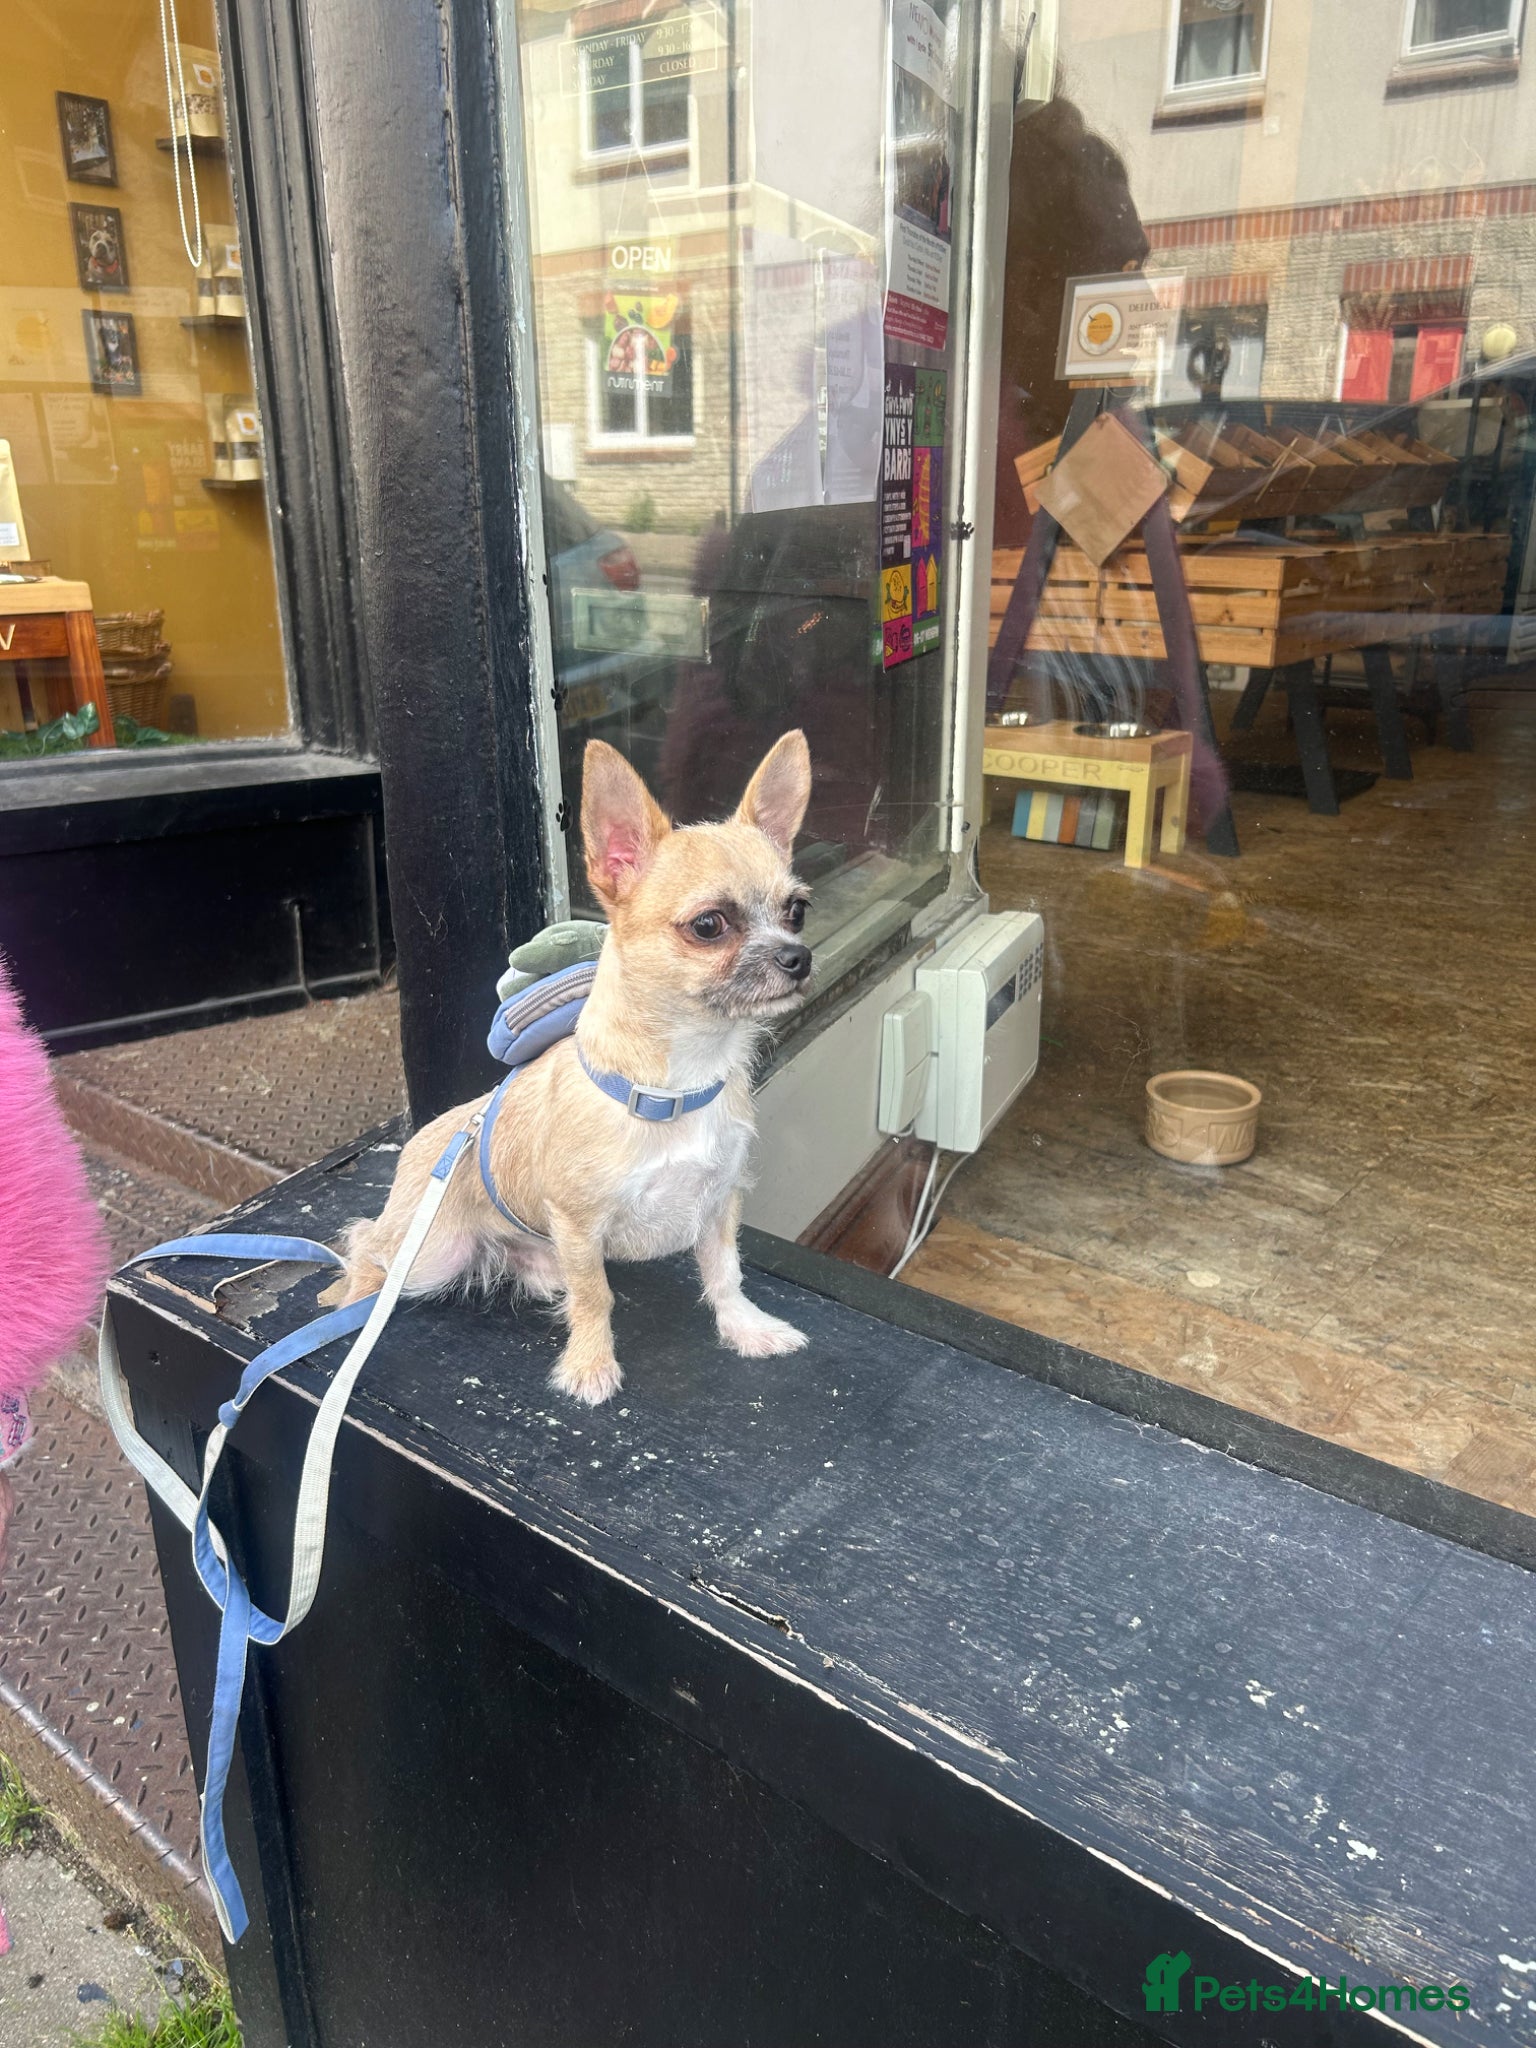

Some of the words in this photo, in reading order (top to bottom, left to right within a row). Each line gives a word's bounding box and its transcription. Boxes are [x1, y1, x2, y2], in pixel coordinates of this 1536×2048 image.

[572, 40, 608, 57] MONDAY
[615, 32, 646, 48] FRIDAY
[659, 57, 696, 74] CLOSED
[611, 245, 672, 272] OPEN
